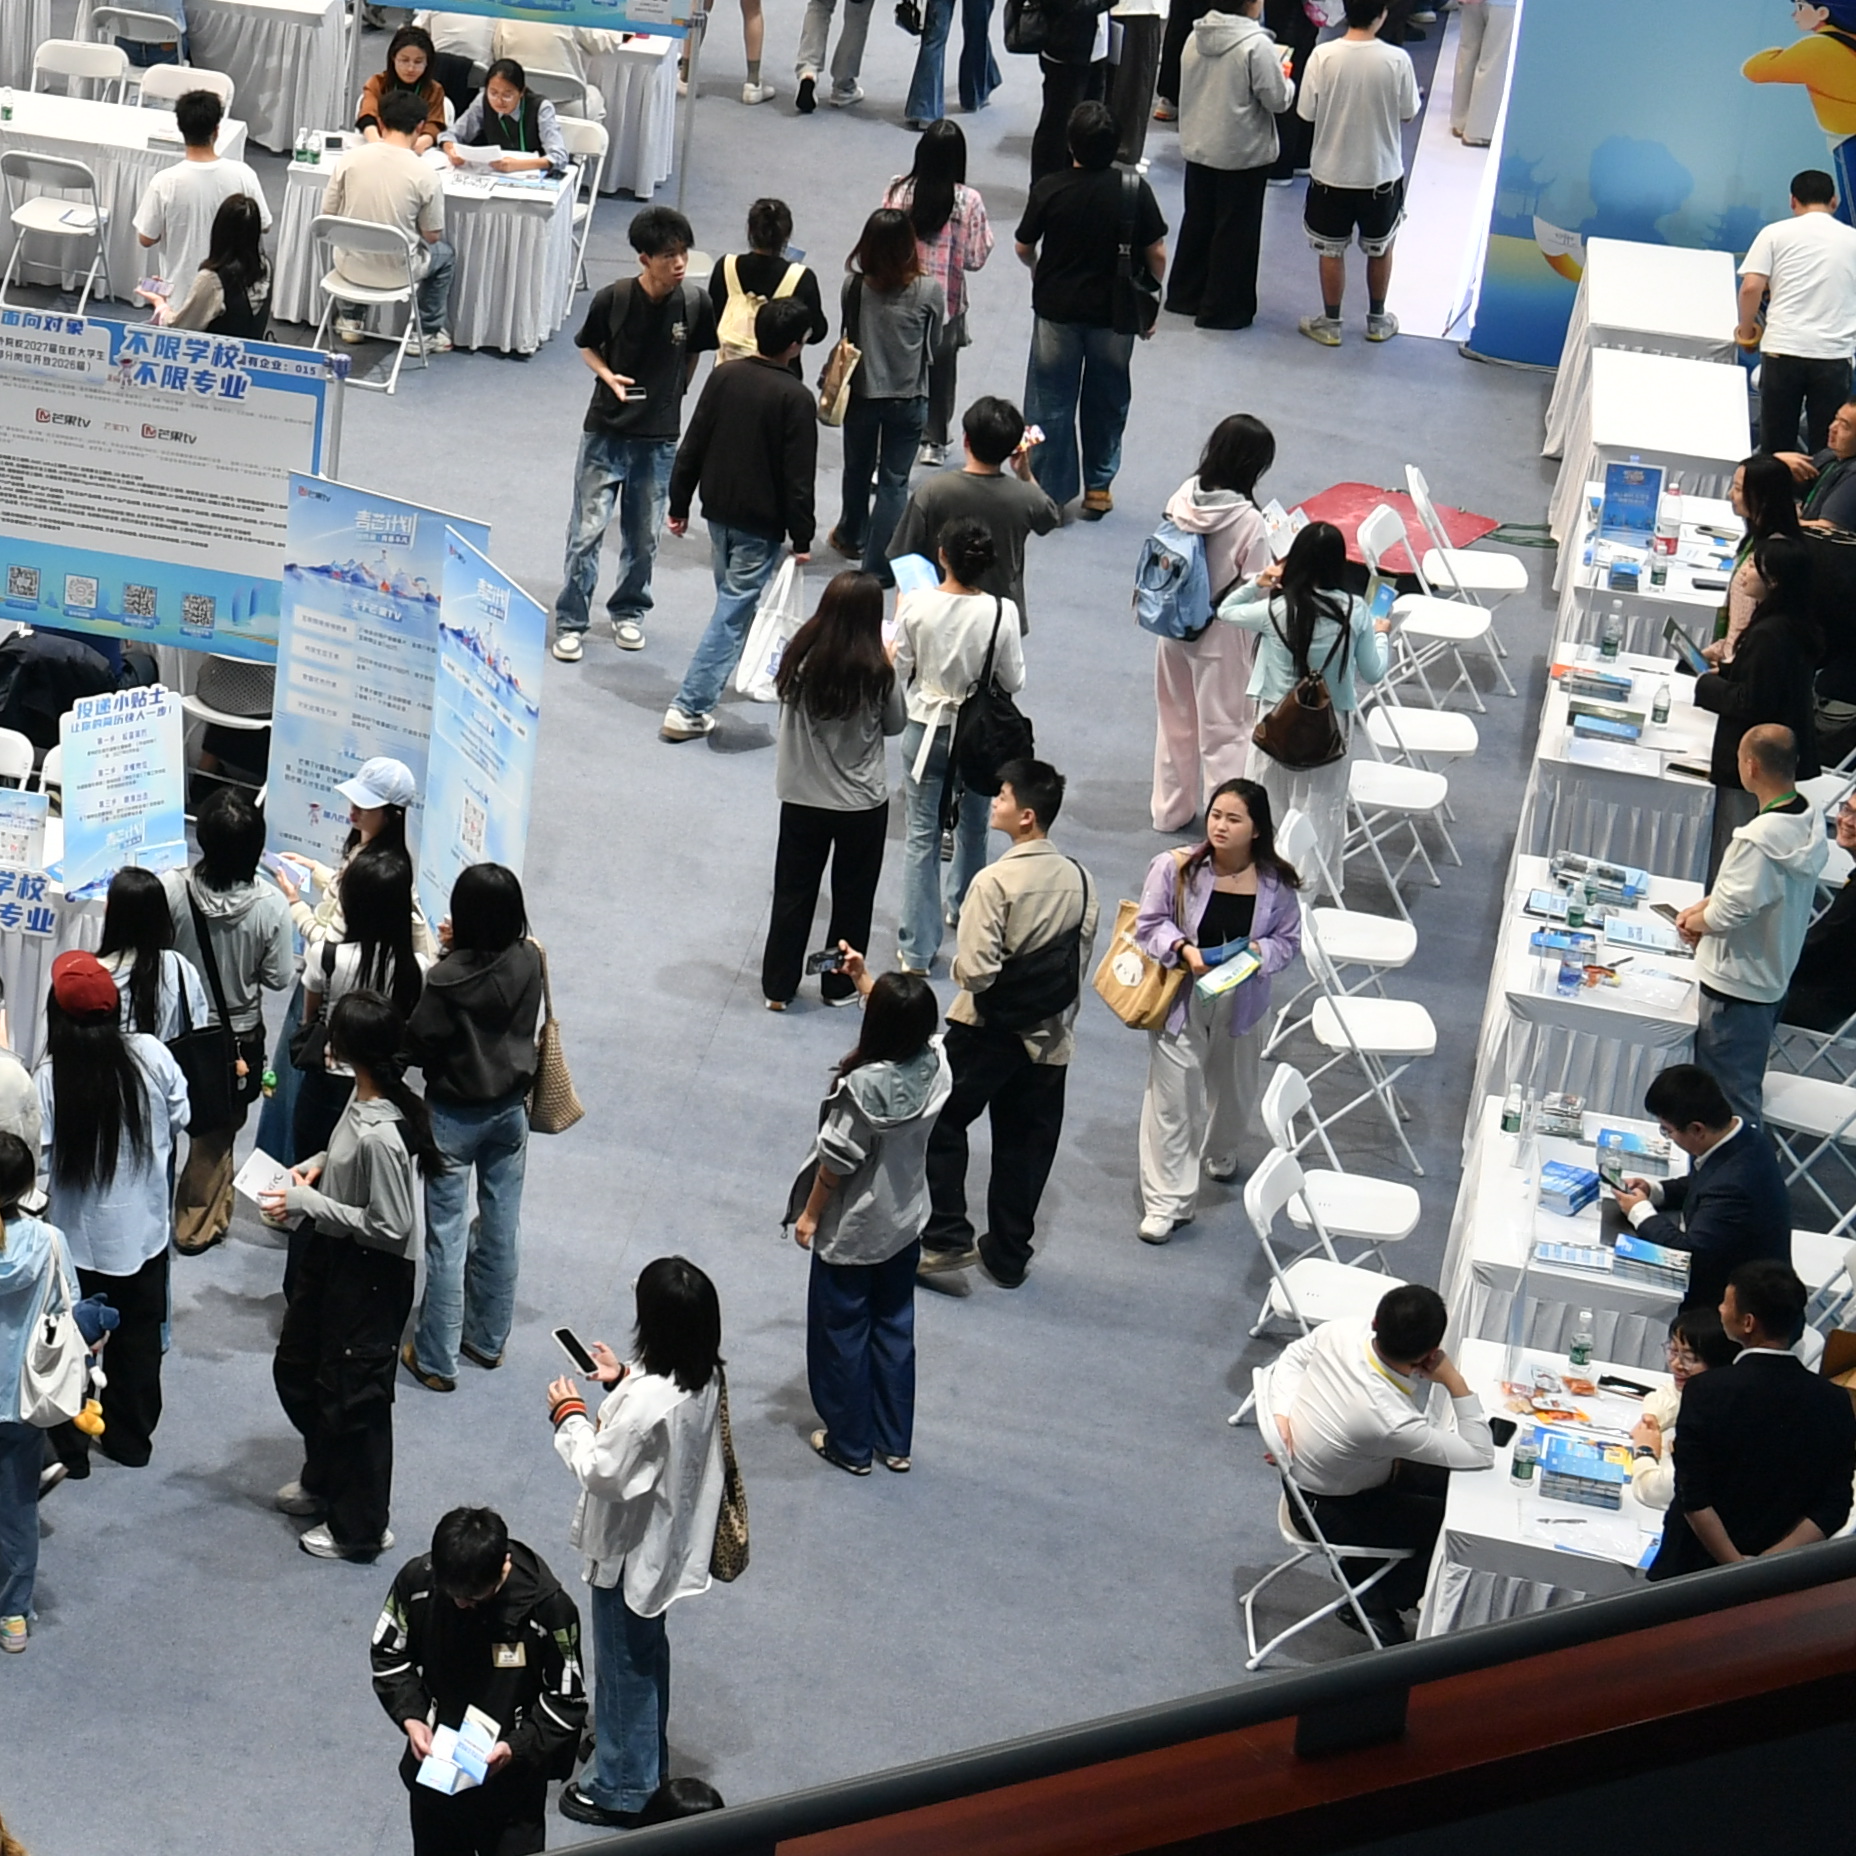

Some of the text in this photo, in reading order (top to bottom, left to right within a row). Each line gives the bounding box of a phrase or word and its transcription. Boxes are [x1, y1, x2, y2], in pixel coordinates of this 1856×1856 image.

[1, 312, 83, 335] 面向对象
[125, 330, 241, 369] 不限学校
[238, 355, 316, 376] 有企业：015
[133, 363, 248, 400] 不限专业
[77, 689, 165, 720] 投递小贴士
